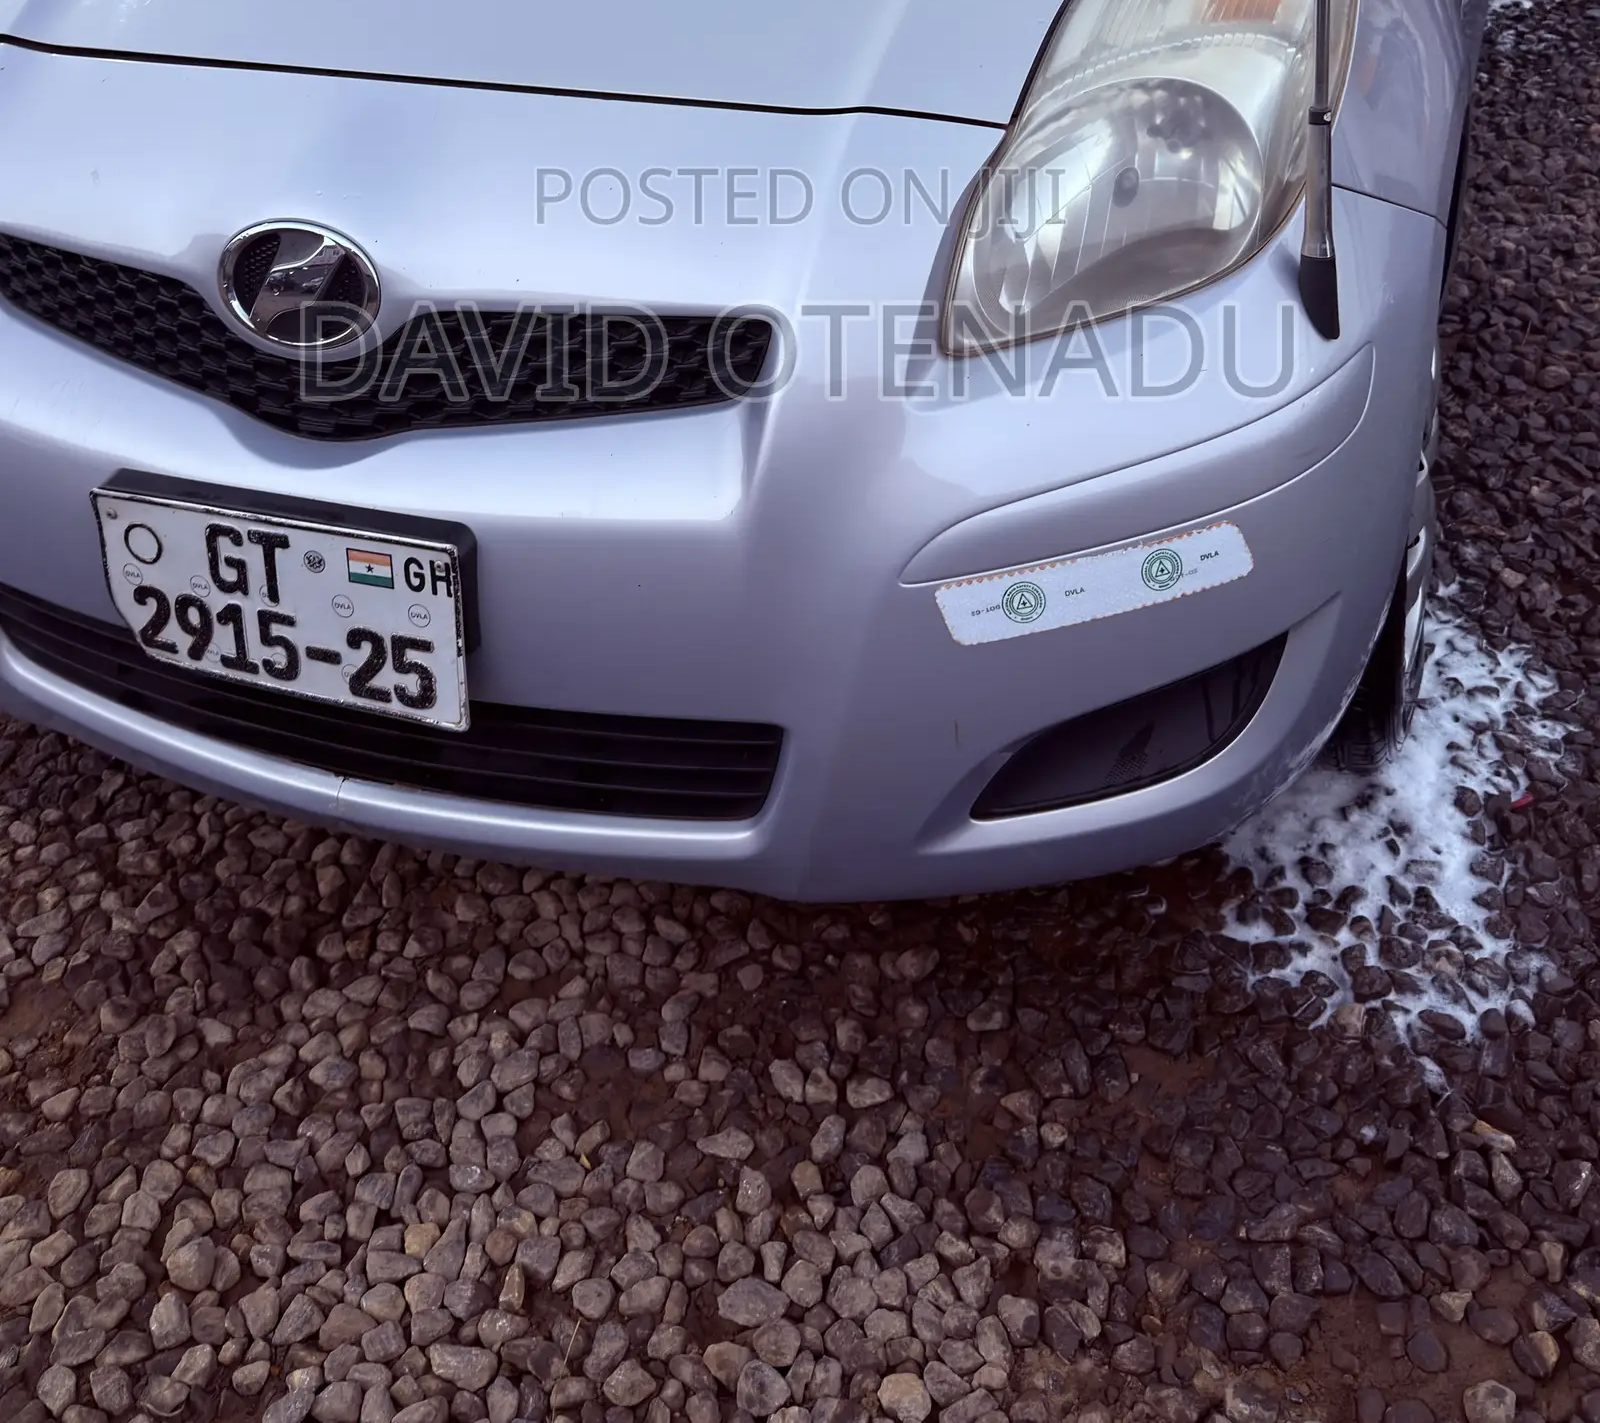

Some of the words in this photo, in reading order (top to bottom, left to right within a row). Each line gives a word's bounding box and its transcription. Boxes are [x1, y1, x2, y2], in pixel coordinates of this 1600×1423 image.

[1200, 551, 1219, 561] DVLA
[205, 522, 290, 604] GT
[403, 556, 453, 598] GH
[1065, 587, 1085, 597] DVLA
[334, 601, 351, 611] DVLA
[410, 611, 428, 620] DVLA
[133, 584, 437, 709] 2915-25
